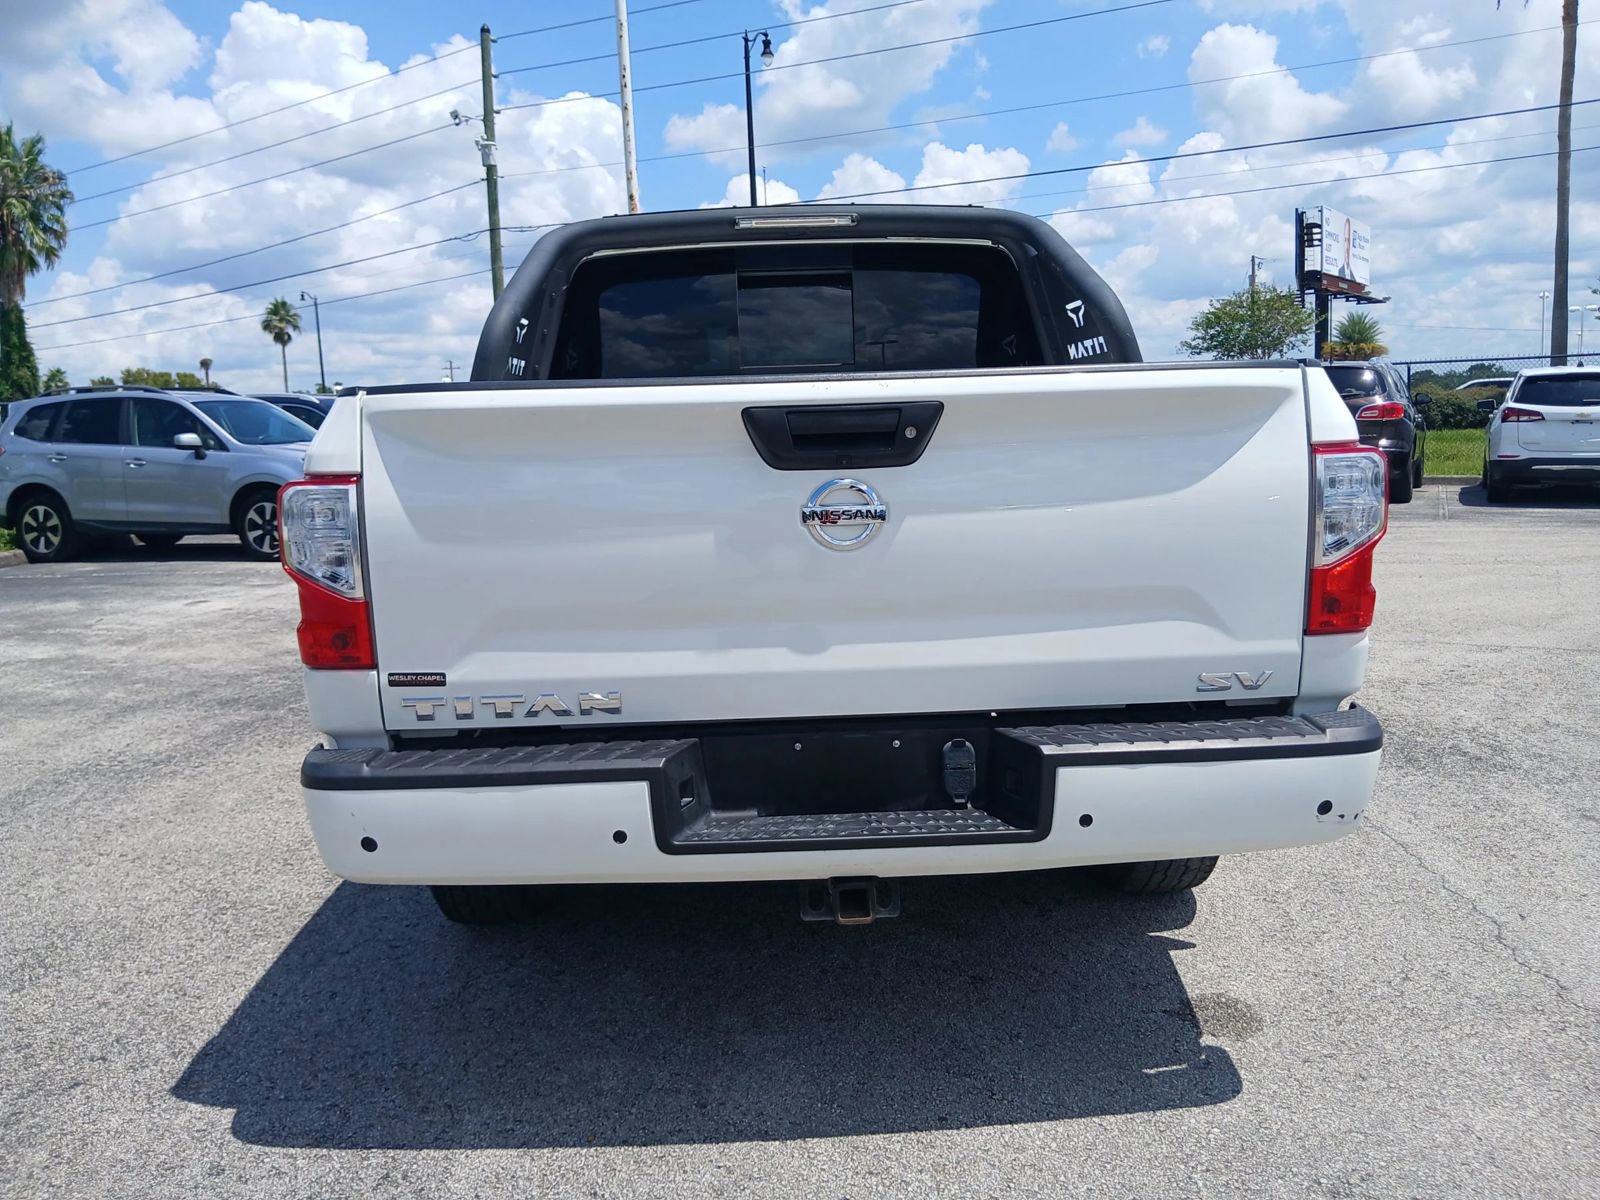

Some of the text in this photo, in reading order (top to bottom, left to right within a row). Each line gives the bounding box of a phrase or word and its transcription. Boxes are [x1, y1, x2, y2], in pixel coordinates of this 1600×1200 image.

[811, 509, 878, 521] NISSAN
[1196, 670, 1273, 693] SV
[401, 691, 622, 721] TITAN
